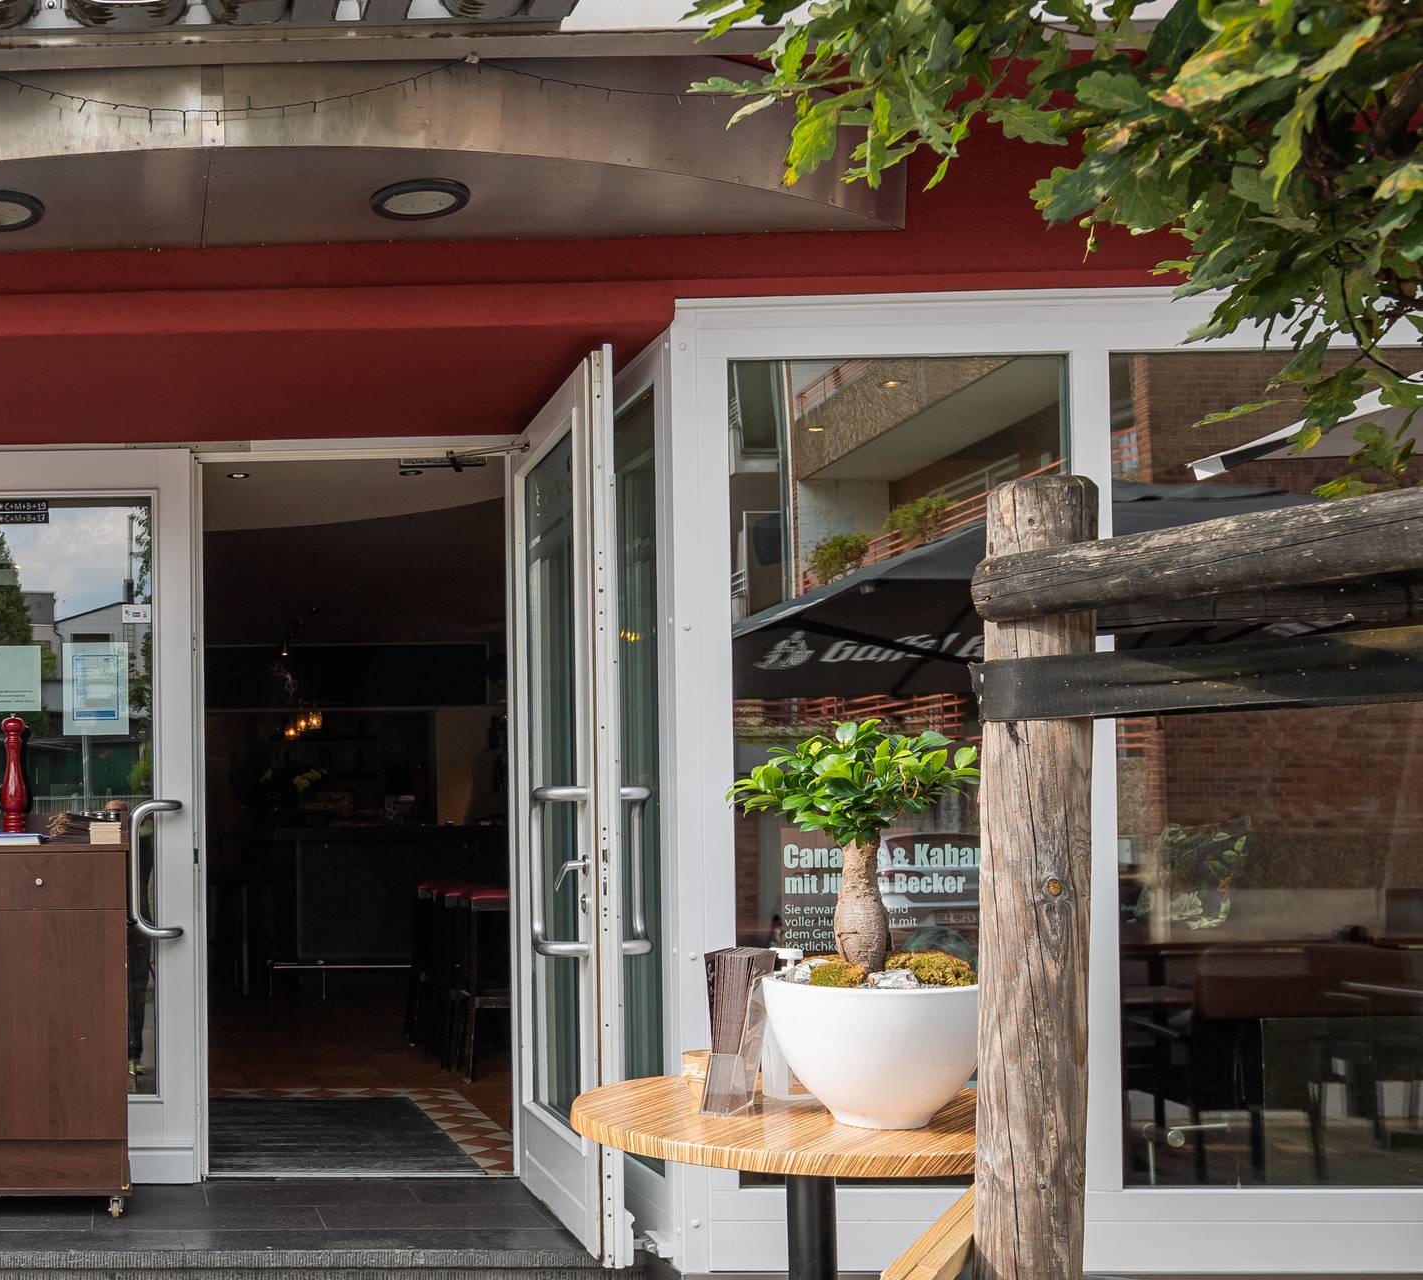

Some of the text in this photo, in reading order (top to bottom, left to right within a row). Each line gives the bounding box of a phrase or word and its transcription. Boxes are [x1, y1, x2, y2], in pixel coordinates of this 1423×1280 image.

[893, 847, 909, 867] &
[784, 873, 818, 894] mit
[894, 873, 966, 894] Becker
[784, 904, 802, 915] Sie
[785, 916, 815, 927] voller
[898, 916, 917, 927] mit
[785, 929, 810, 939] dem
